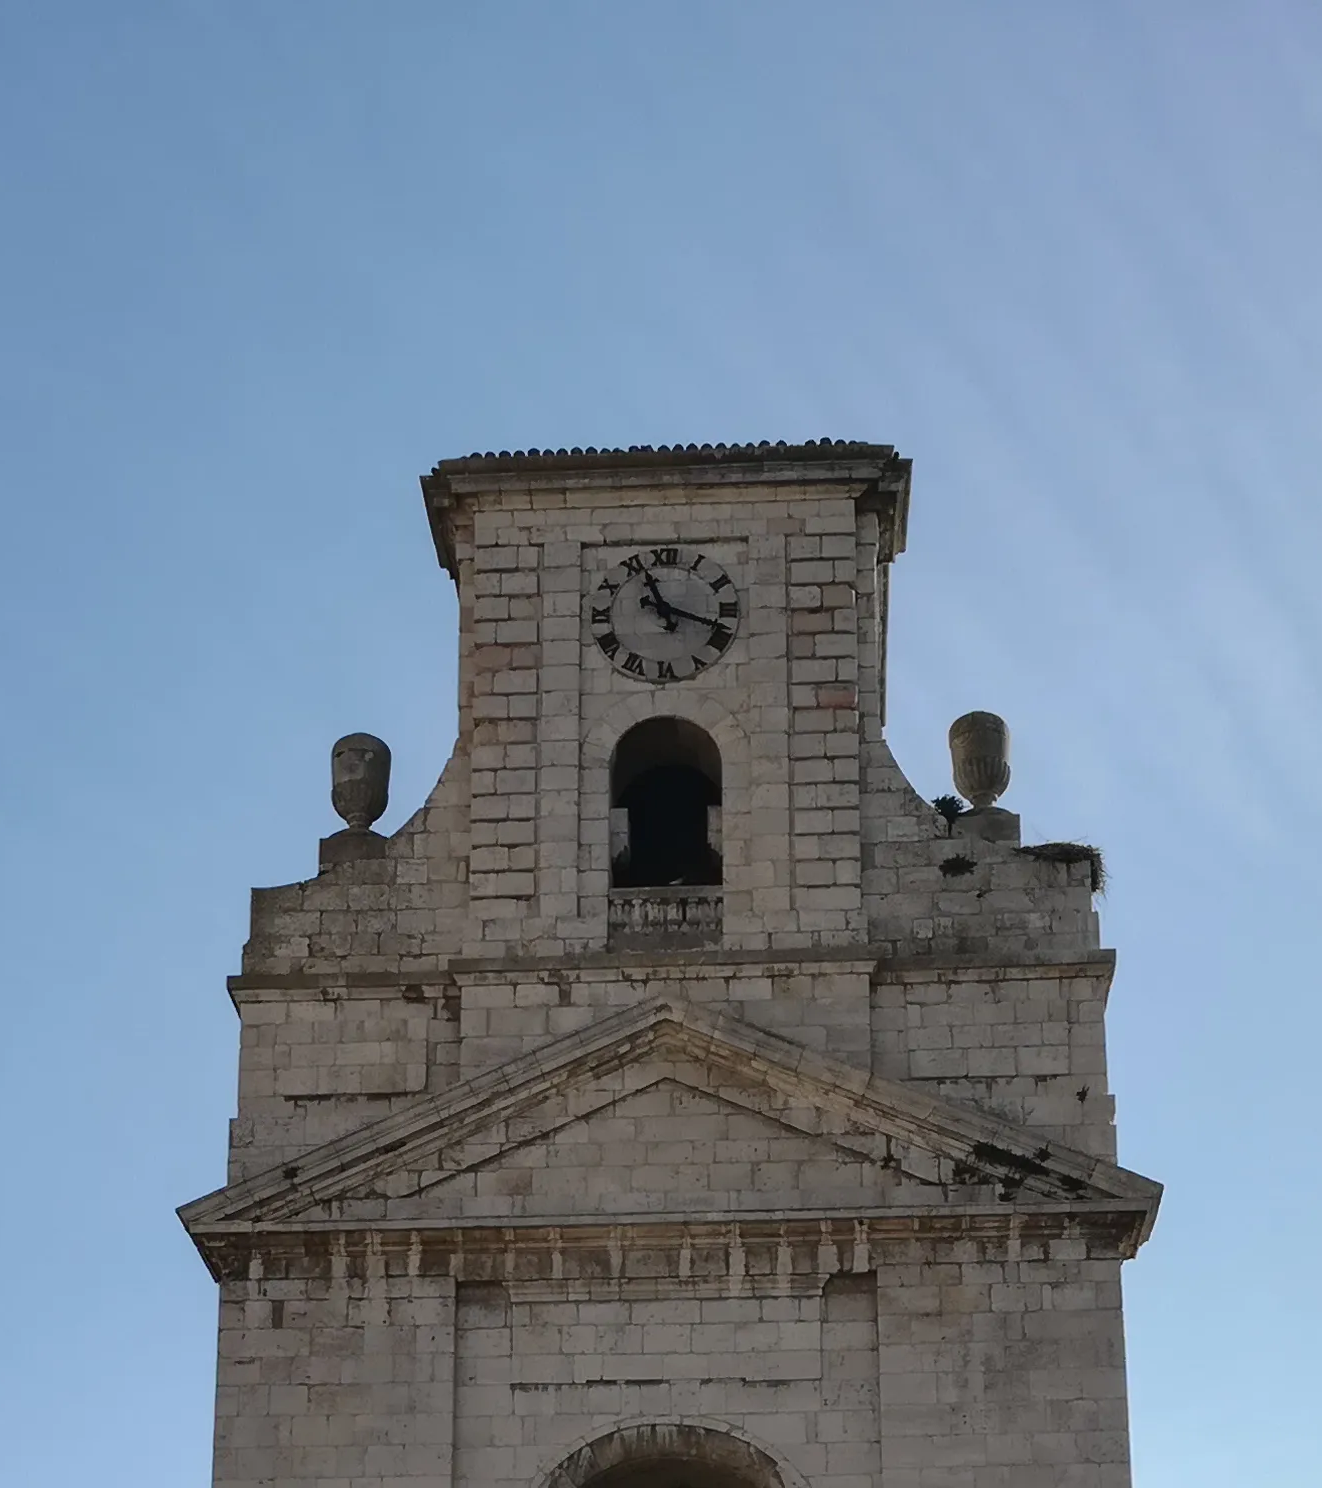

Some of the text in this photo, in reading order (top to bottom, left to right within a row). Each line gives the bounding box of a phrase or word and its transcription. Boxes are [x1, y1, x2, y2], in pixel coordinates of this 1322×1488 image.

[620, 554, 646, 577] XI
[650, 548, 679, 566] XII
[689, 554, 706, 571] I
[598, 578, 621, 596] X
[709, 574, 732, 596] II
[591, 606, 611, 624] IX
[719, 601, 738, 618] III
[621, 652, 646, 676] VII
[657, 661, 680, 678] VI
[691, 655, 708, 672] V
